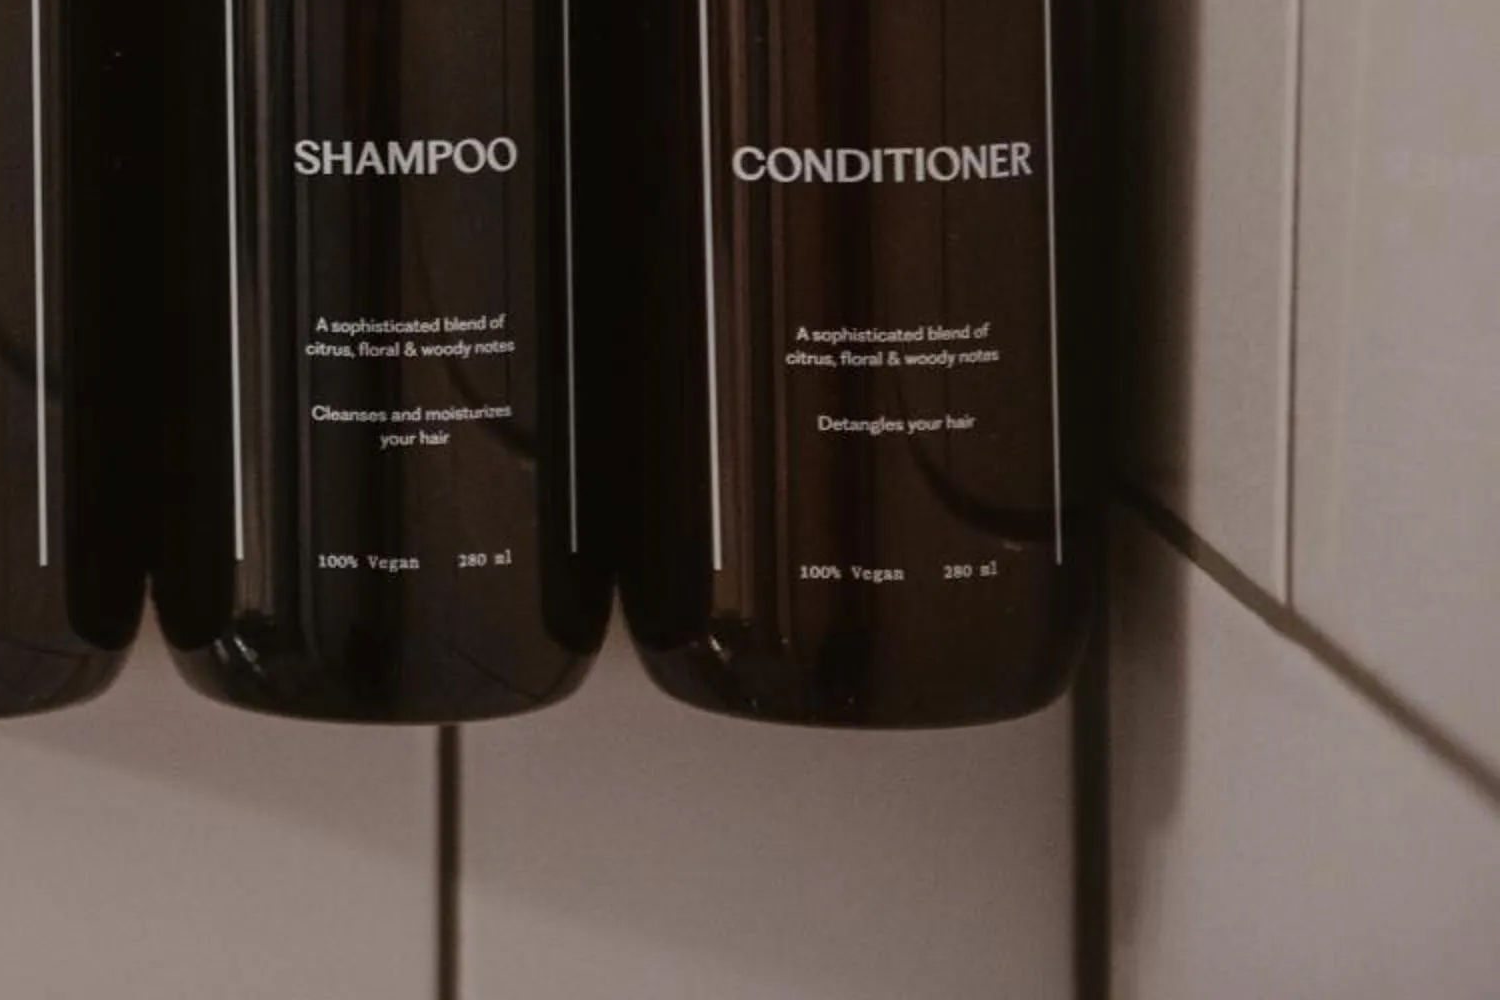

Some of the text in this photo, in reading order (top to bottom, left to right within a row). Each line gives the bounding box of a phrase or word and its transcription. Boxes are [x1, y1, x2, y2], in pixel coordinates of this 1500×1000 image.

[294, 137, 517, 176] SHAMPOO
[732, 142, 1033, 184] CONDITIONER
[316, 314, 506, 336] A sophisticated blend of
[796, 322, 991, 344] A sophisticated blend of
[305, 339, 515, 358] citrus, floral & woody notes
[785, 348, 999, 368] citrus, floral & woody notes
[311, 405, 512, 422] Cleanses and moisturizes
[817, 414, 976, 436] Detangles your hair
[380, 430, 450, 449] your hair
[318, 554, 420, 572] 100% Vegan
[458, 549, 512, 568] 280 ml
[800, 565, 904, 584] 100% Vegan
[944, 560, 998, 579] 280 ml
